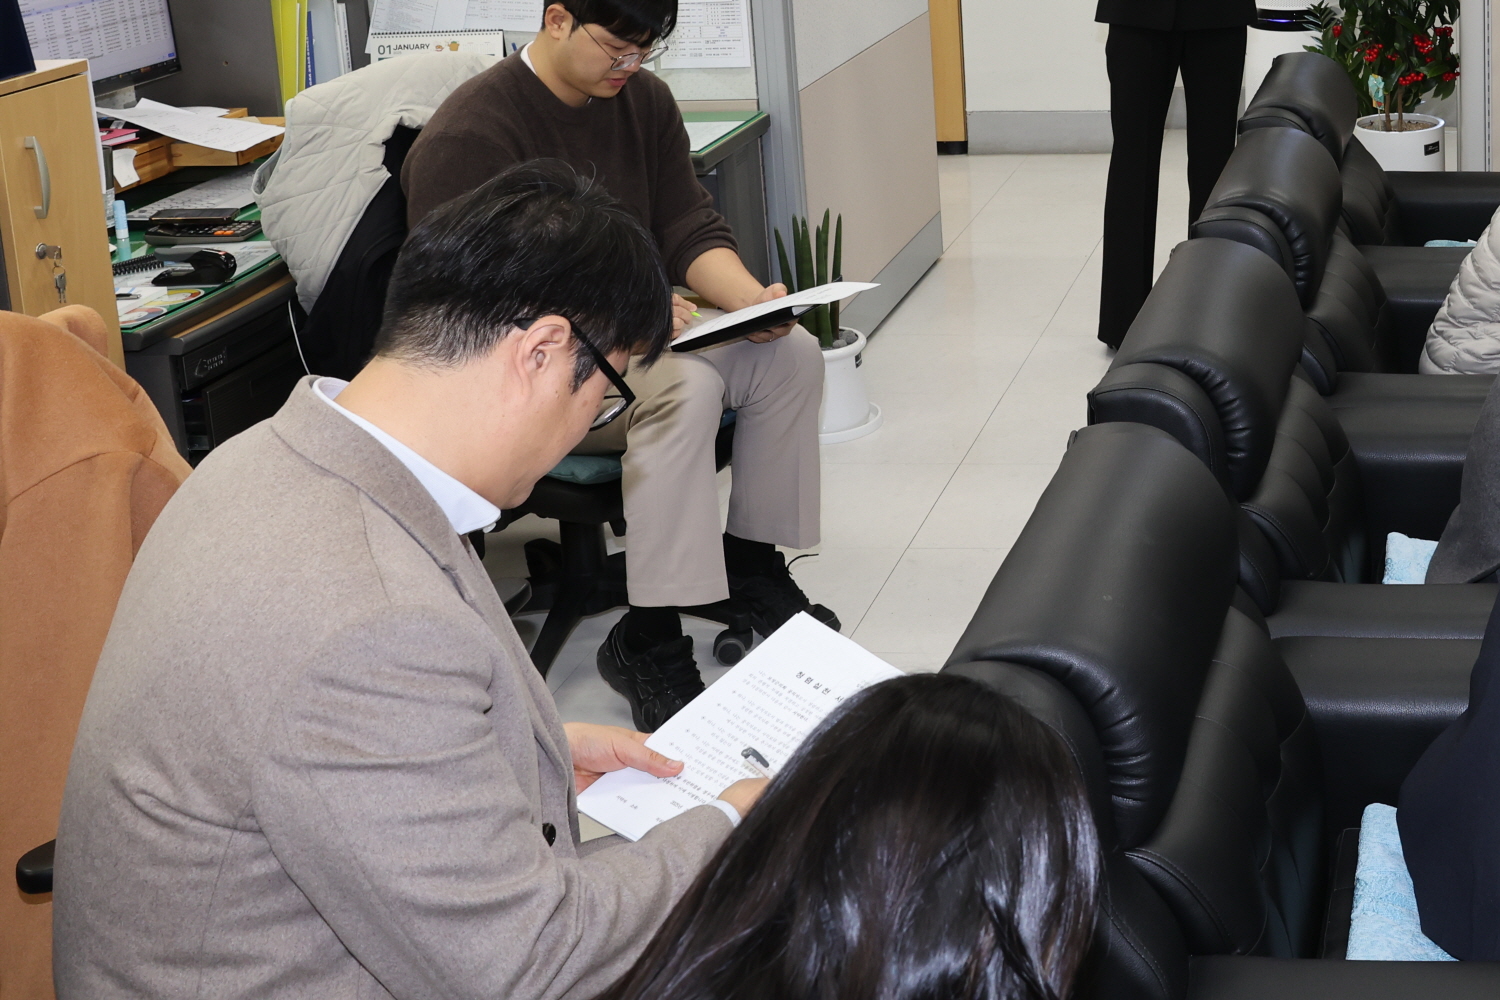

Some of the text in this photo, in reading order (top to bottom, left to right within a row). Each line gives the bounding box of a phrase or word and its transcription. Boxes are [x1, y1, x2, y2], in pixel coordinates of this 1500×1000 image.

[377, 43, 430, 55] 01 JANUARY
[795, 670, 831, 696] 청렴실천
